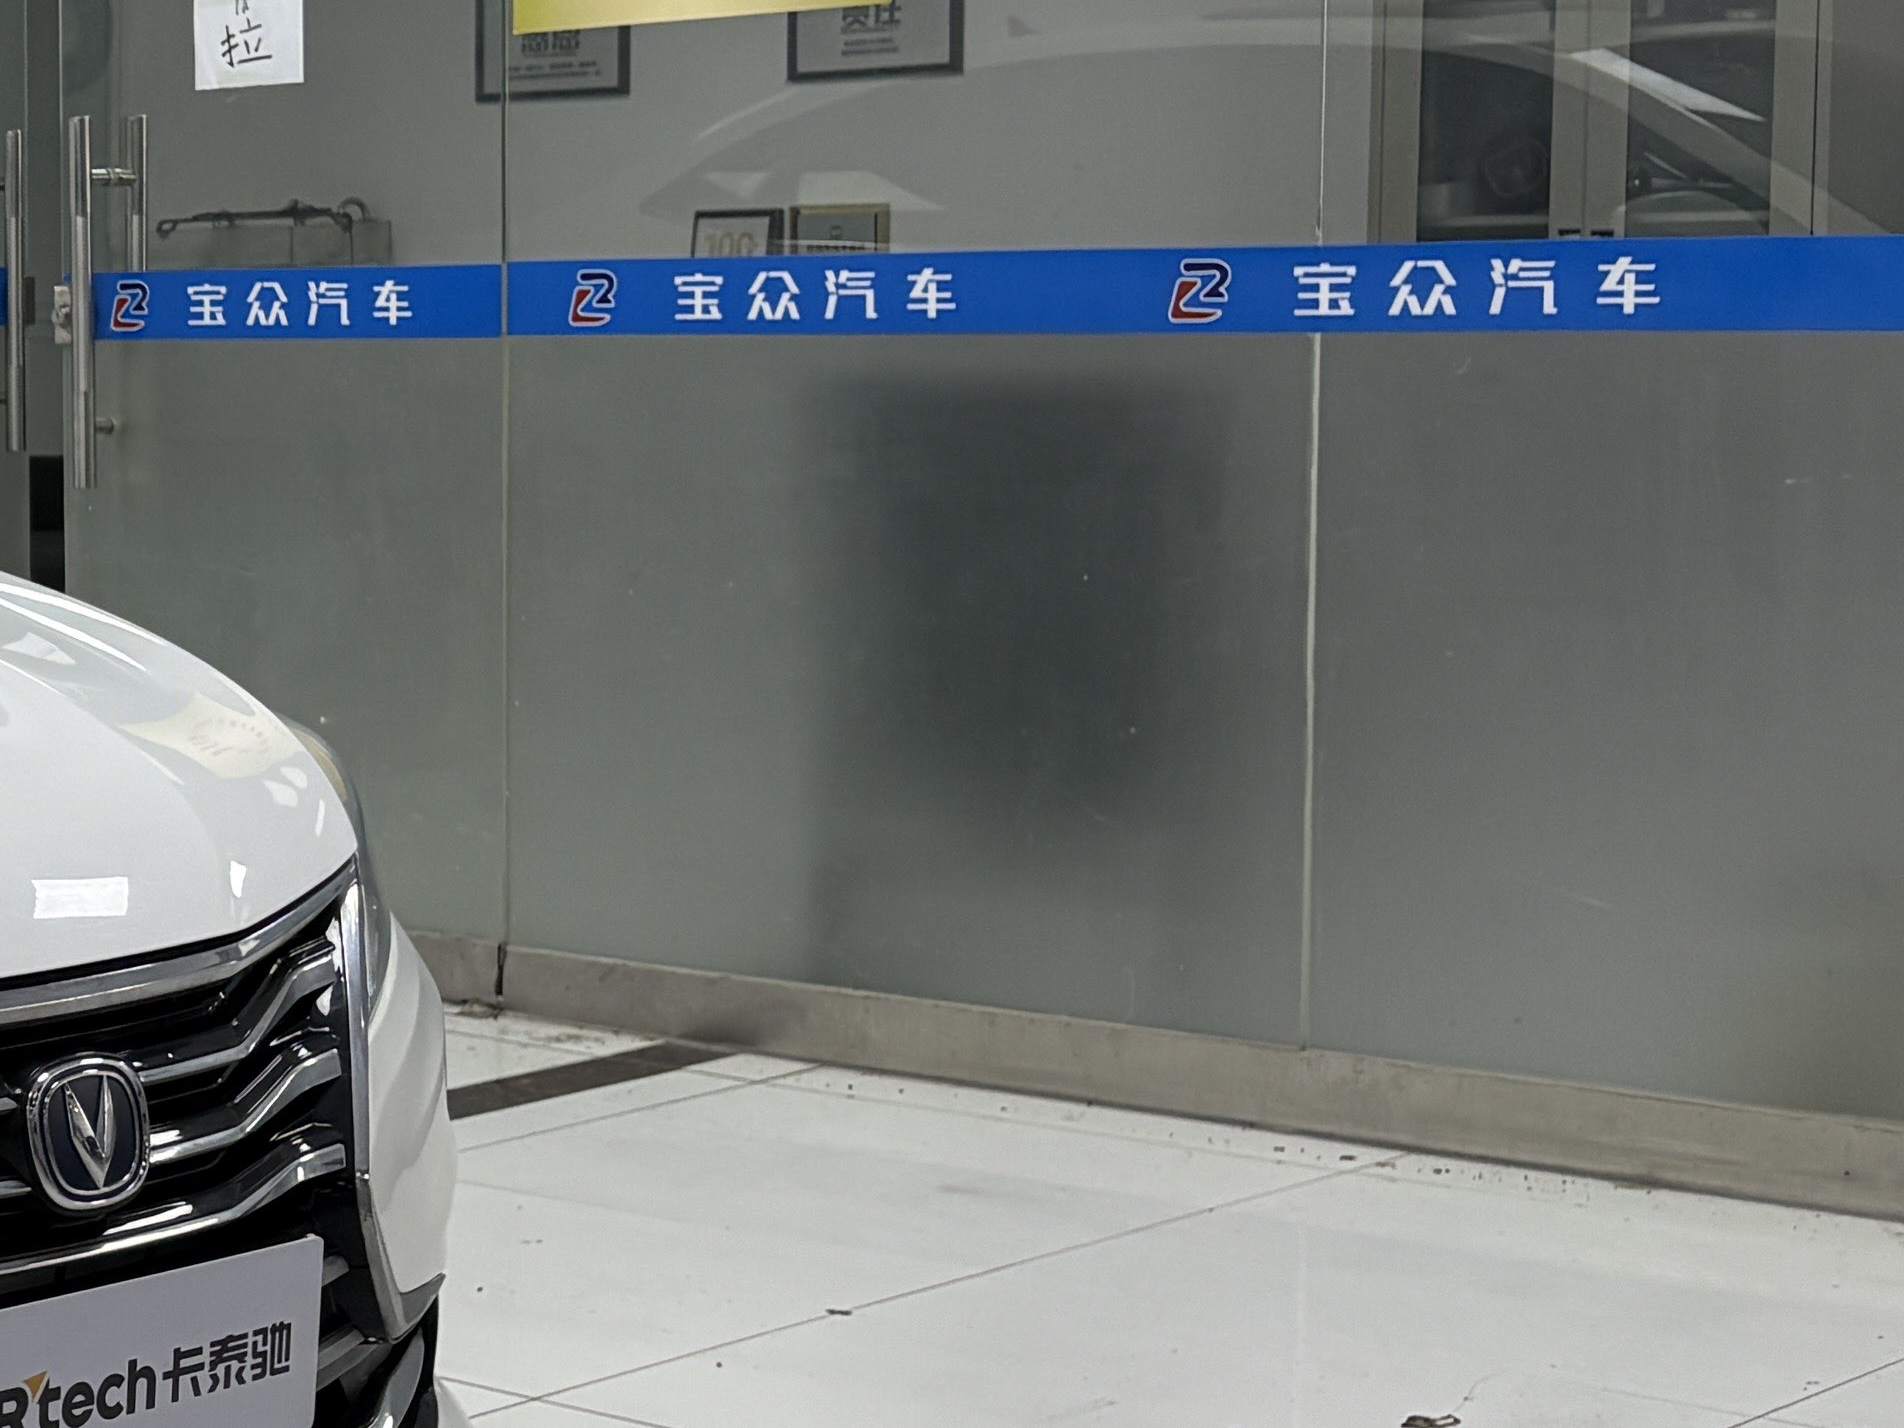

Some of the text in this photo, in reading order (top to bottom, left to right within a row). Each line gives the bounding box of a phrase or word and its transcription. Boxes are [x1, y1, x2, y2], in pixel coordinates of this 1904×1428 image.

[220, 17, 274, 69] 拉
[187, 280, 414, 326] 宝众汽车
[673, 267, 958, 322] 宝众汽车
[1293, 256, 1661, 315] 宝众汽车
[162, 1320, 293, 1404] 卡泰驰
